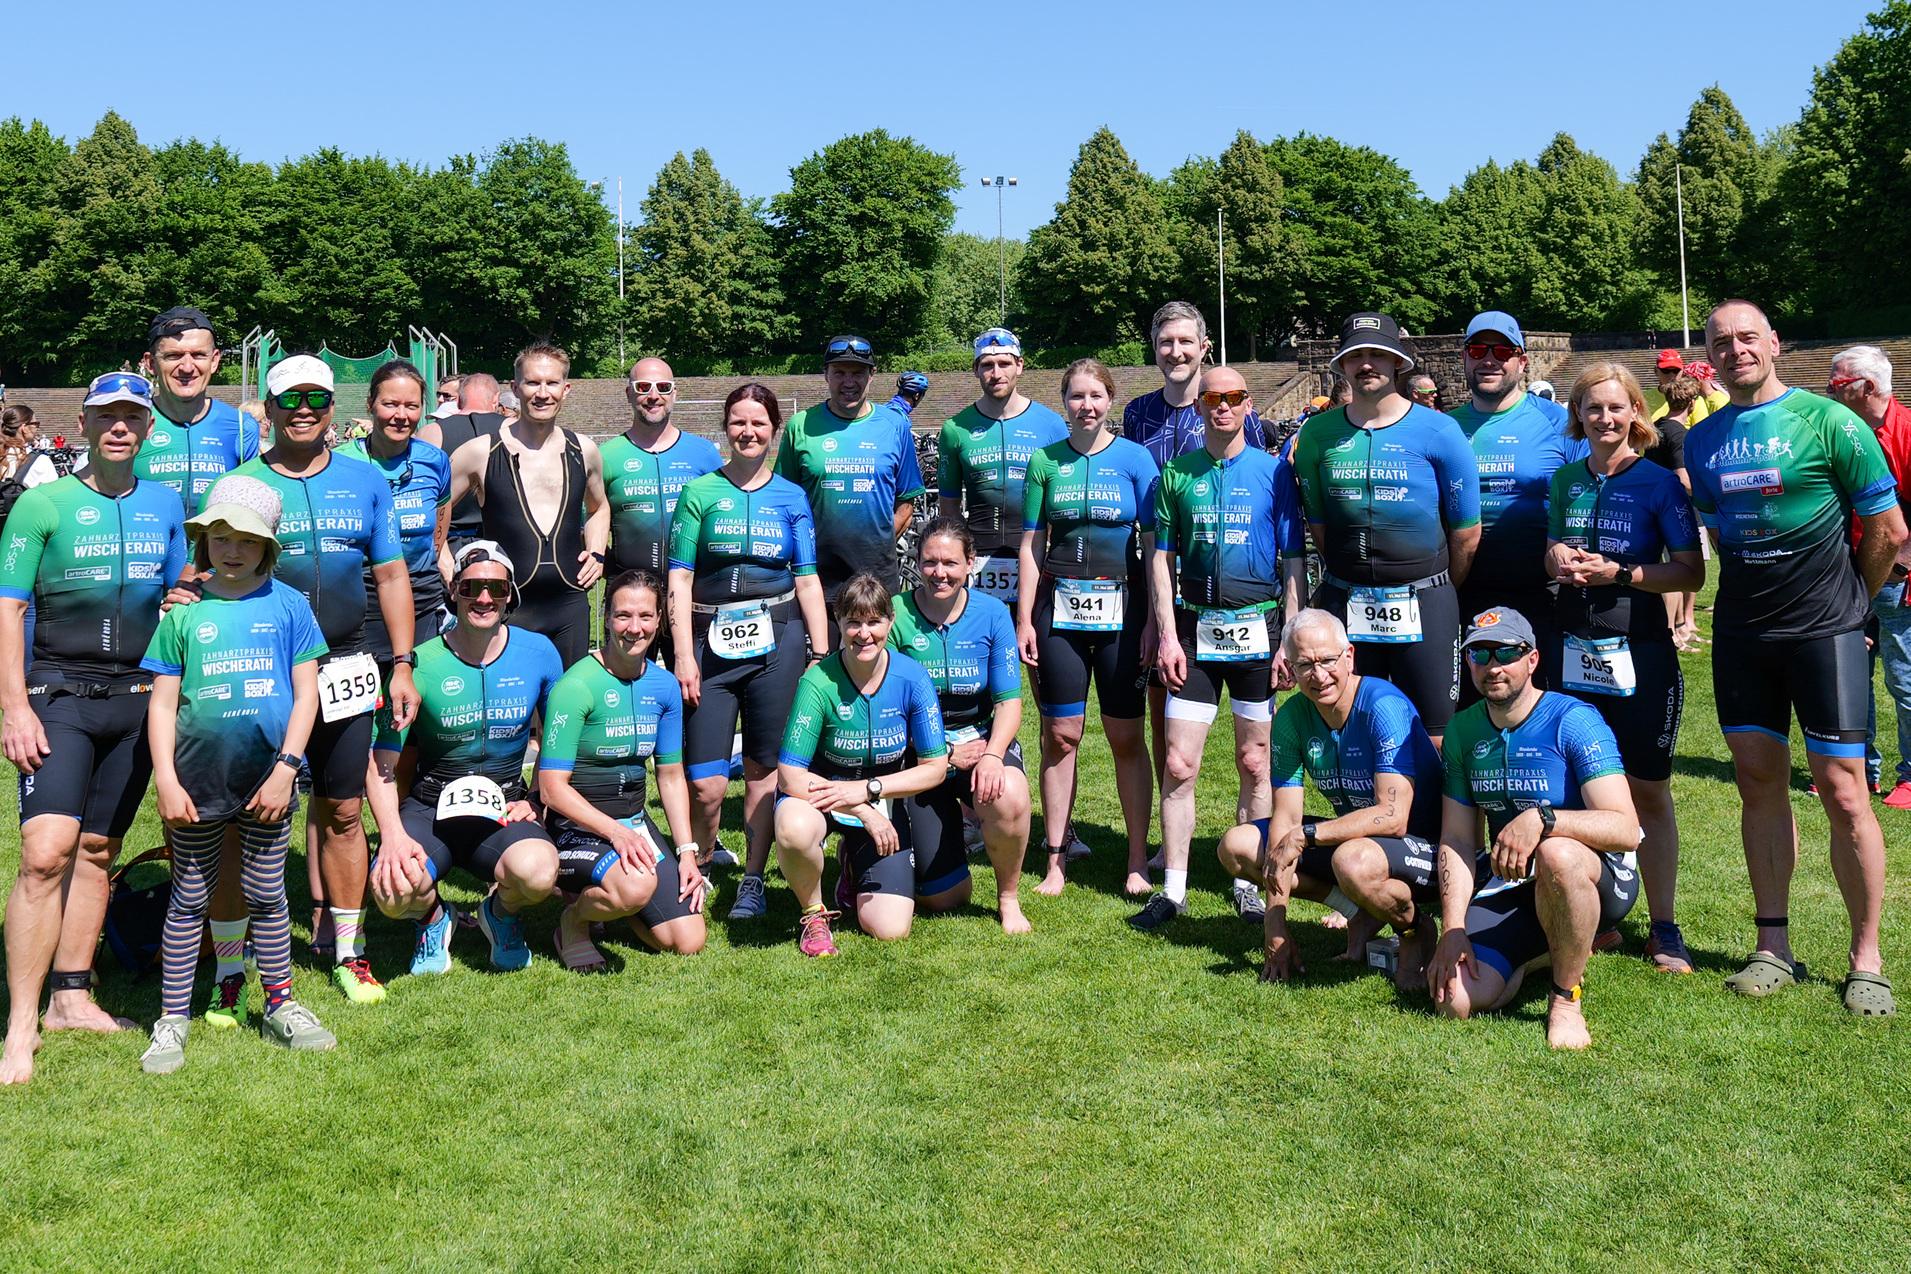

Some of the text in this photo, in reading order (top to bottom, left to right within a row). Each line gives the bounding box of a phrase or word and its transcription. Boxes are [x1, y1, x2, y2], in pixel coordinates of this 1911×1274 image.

[824, 464, 875, 474] WISCHERATH
[1724, 474, 1772, 489] artroCARE
[975, 572, 1018, 589] 1357
[1069, 597, 1103, 611] 941
[1073, 613, 1102, 621] Alena
[1364, 606, 1402, 622] 948
[721, 623, 760, 641] 962
[1212, 627, 1250, 641] 912
[1370, 624, 1397, 633] Marc
[728, 640, 756, 650] Steffi
[202, 657, 273, 677] WISCHERATH
[1581, 654, 1614, 675] 905
[1583, 672, 1615, 686] Nicole
[327, 672, 376, 704] 1359
[445, 788, 502, 811] 1358
